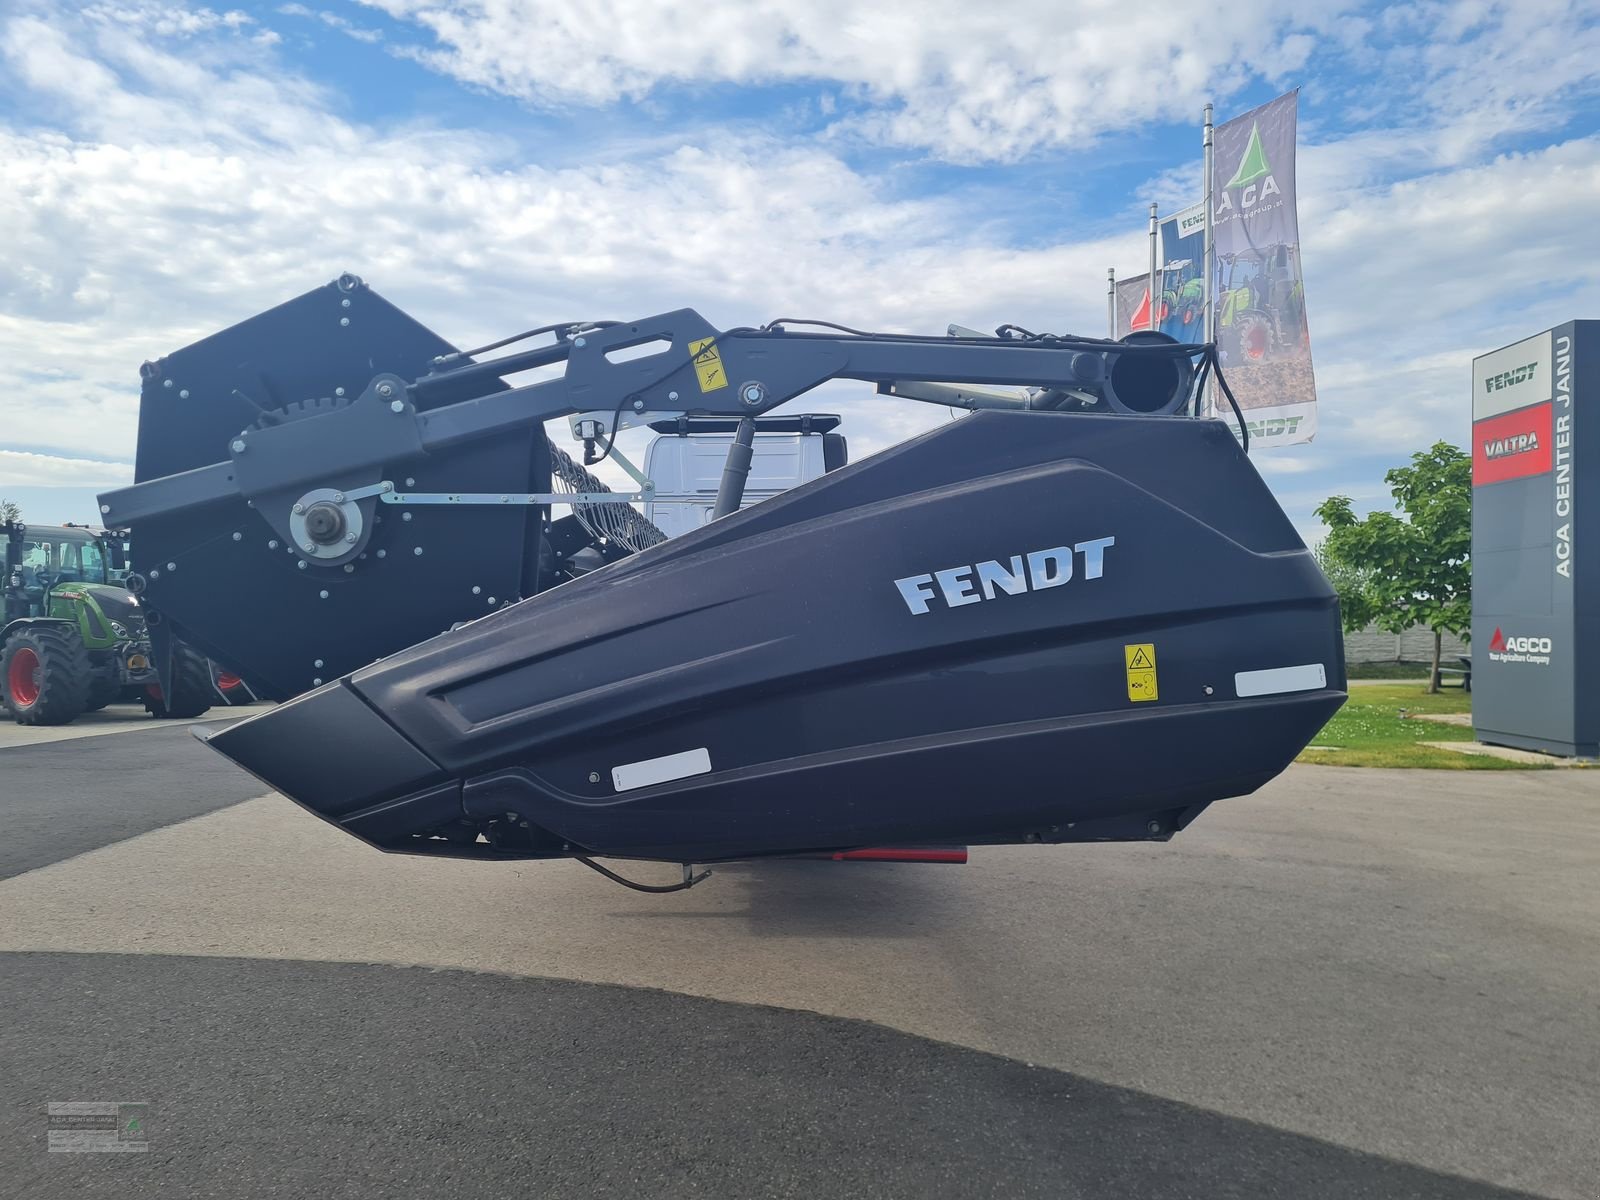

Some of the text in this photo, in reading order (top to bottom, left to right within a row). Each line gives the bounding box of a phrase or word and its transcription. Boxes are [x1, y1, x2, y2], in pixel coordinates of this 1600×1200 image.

[1215, 175, 1281, 215] ACA
[1181, 212, 1205, 229] FEND
[1485, 362, 1538, 393] FENDT
[1228, 415, 1304, 440] ENDT
[1484, 431, 1539, 461] VALTRA
[1556, 336, 1571, 578] ACA CENTER JANU
[894, 536, 1115, 615] FENDT
[1506, 637, 1552, 653] AGCO
